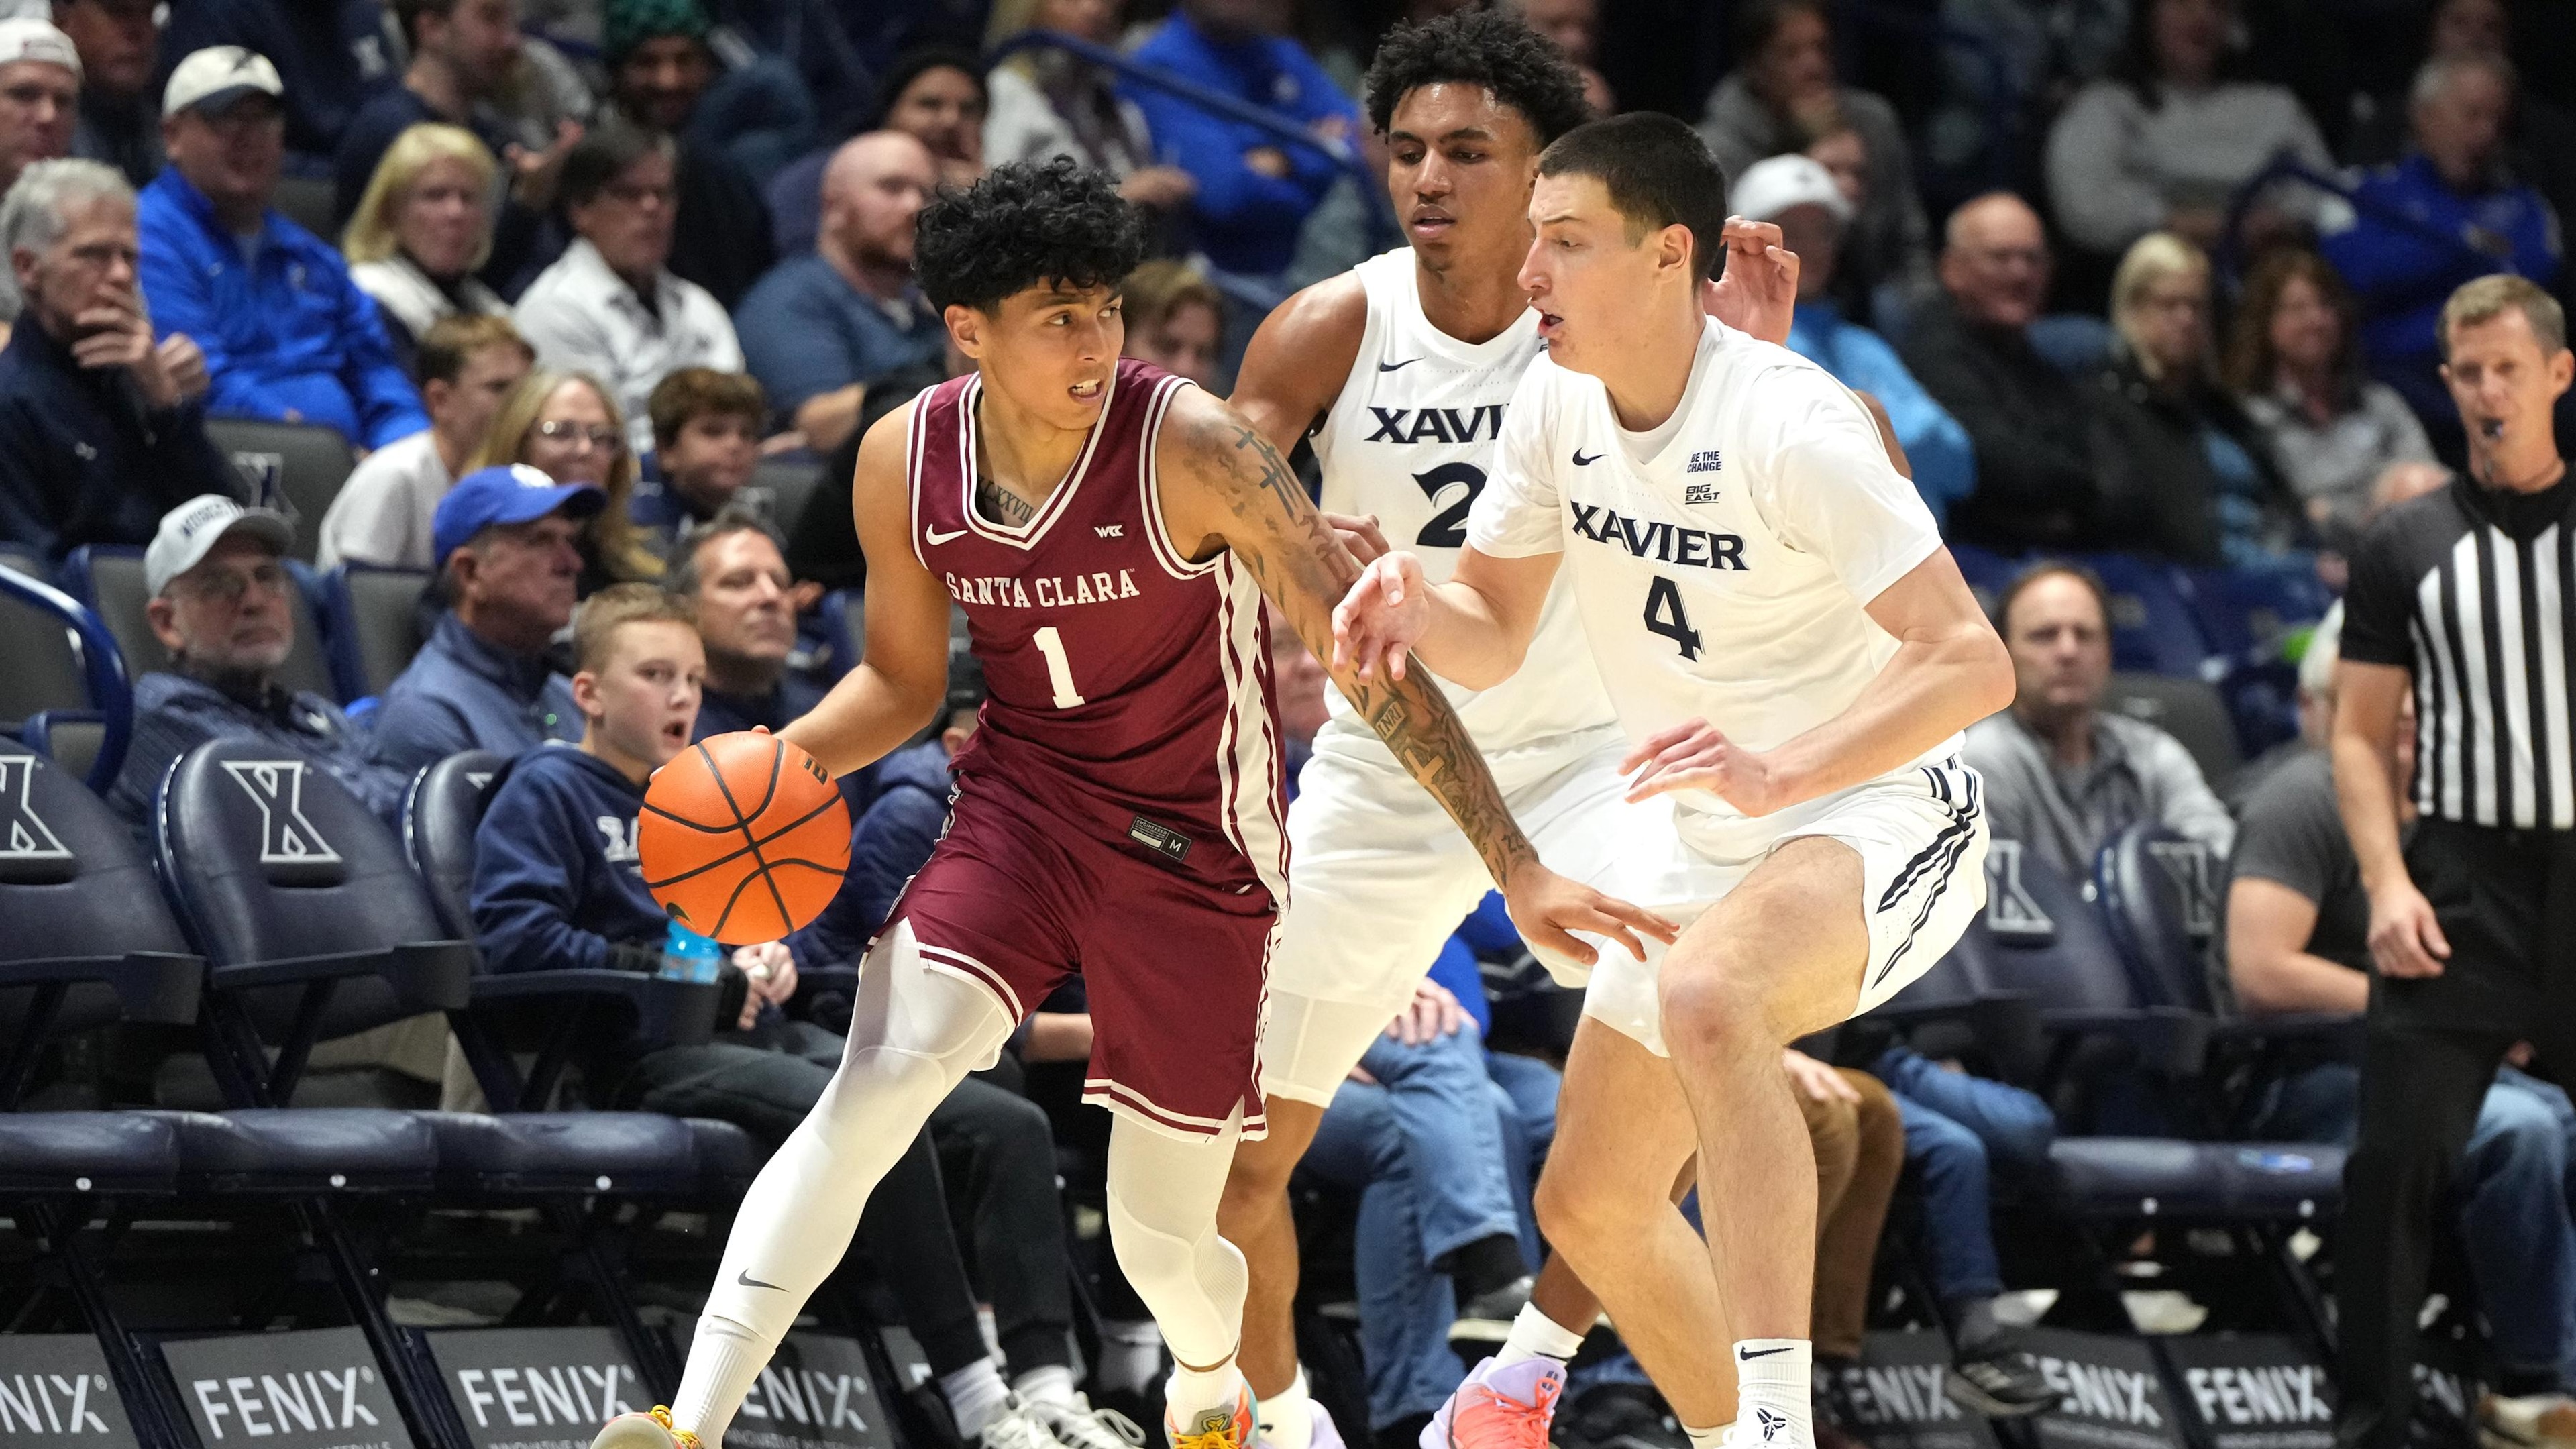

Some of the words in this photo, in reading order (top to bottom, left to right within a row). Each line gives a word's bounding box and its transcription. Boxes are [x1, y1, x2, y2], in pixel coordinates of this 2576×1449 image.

[1364, 403, 1510, 443] XAVI
[1687, 461, 1721, 473] CHANGE
[1691, 453, 1700, 463] BE
[1703, 451, 1719, 461] THE
[1411, 462, 1489, 548] 2
[1685, 492, 1720, 502] EAST
[1686, 484, 1711, 494] BIG
[1093, 525, 1124, 539] WCC
[1570, 500, 1750, 571] XAVIER
[946, 572, 1031, 608] SANTA
[1643, 575, 1703, 663] 4
[1032, 626, 1086, 709] 1
[1377, 704, 1403, 737] INRI
[1169, 839, 1182, 853] M
[193, 1366, 379, 1439] FENIX
[458, 1364, 635, 1428] FENIX
[741, 1366, 868, 1432] NIX
[2186, 1364, 2332, 1424] FENIX
